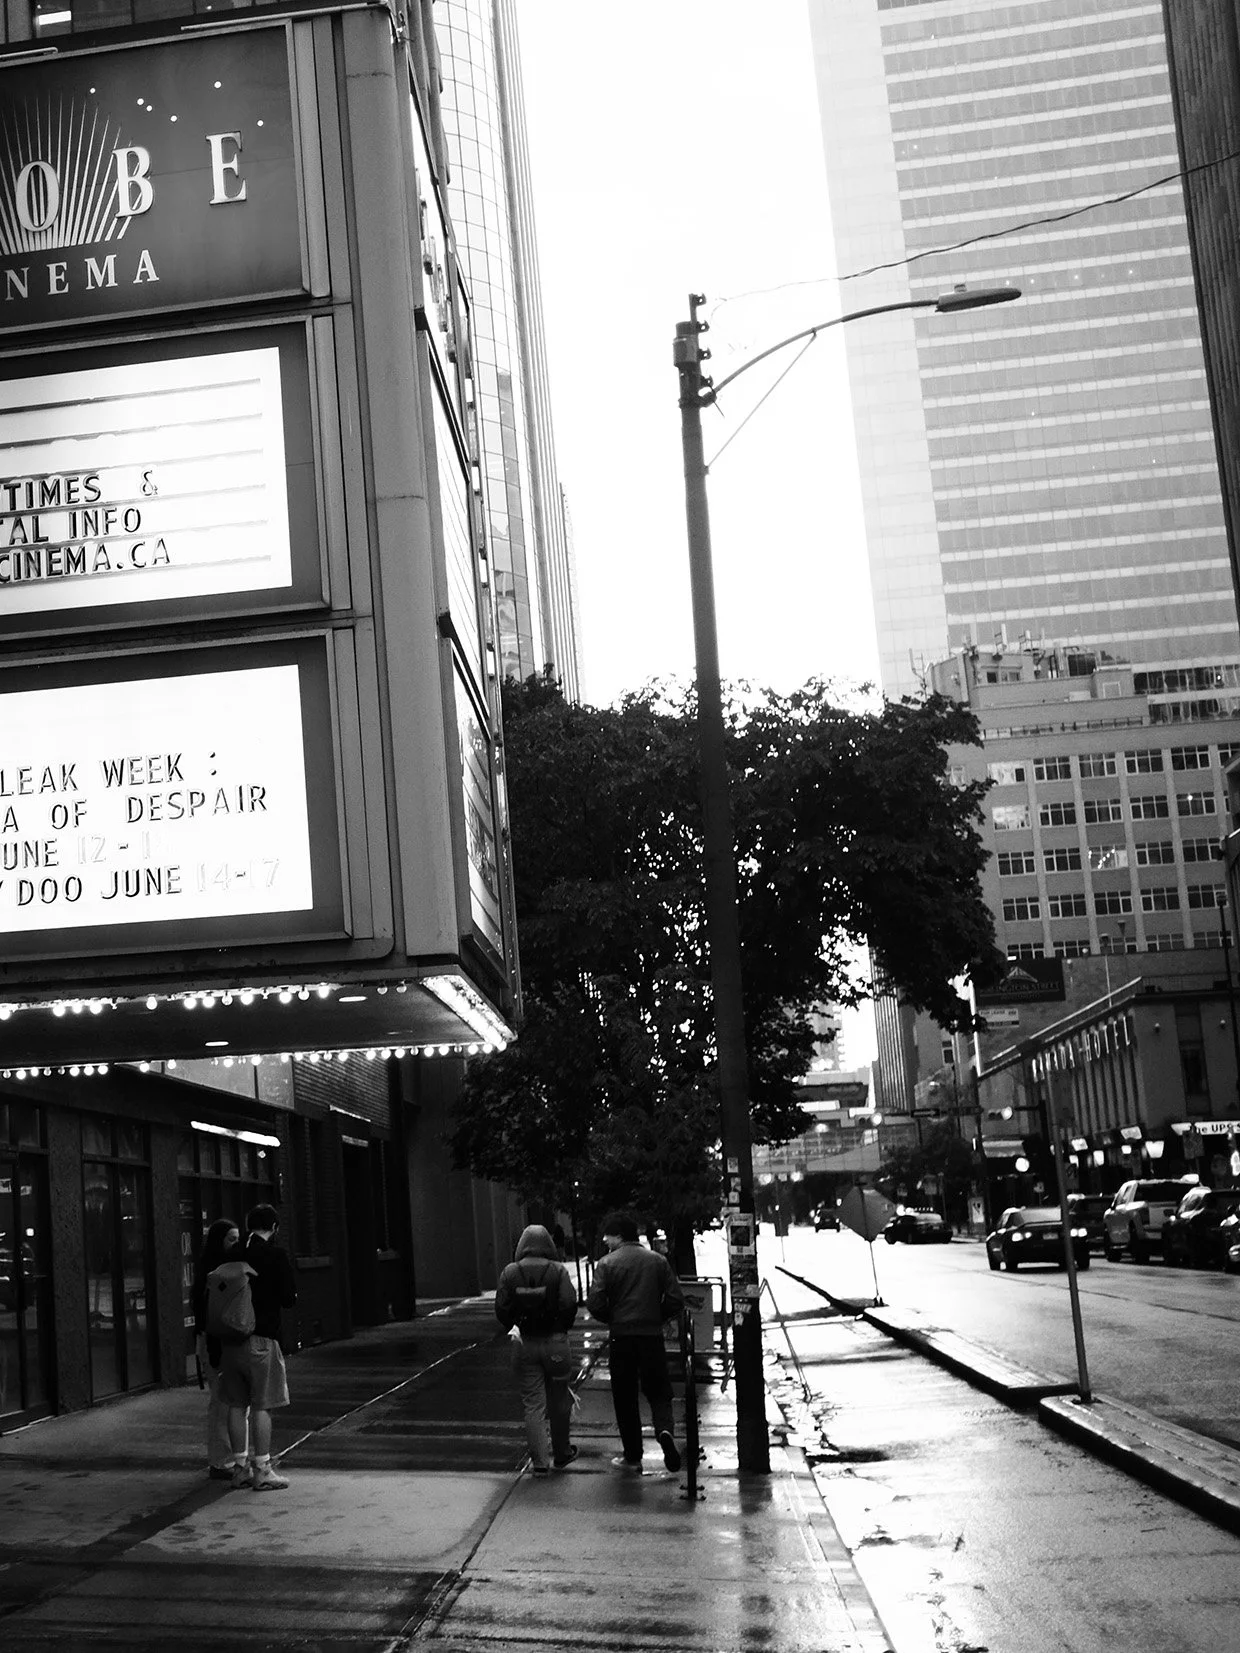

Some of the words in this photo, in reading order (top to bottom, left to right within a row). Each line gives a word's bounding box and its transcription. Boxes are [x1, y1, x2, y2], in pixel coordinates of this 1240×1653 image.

[140, 470, 159, 497] &
[68, 507, 142, 540] INFO
[99, 751, 185, 789] WEEK
[49, 798, 89, 831] OF
[125, 783, 270, 825] DESPAIR
[16, 875, 84, 909] DOO
[100, 864, 184, 901] JUNE
[1081, 1016, 1130, 1061] HOTEL
